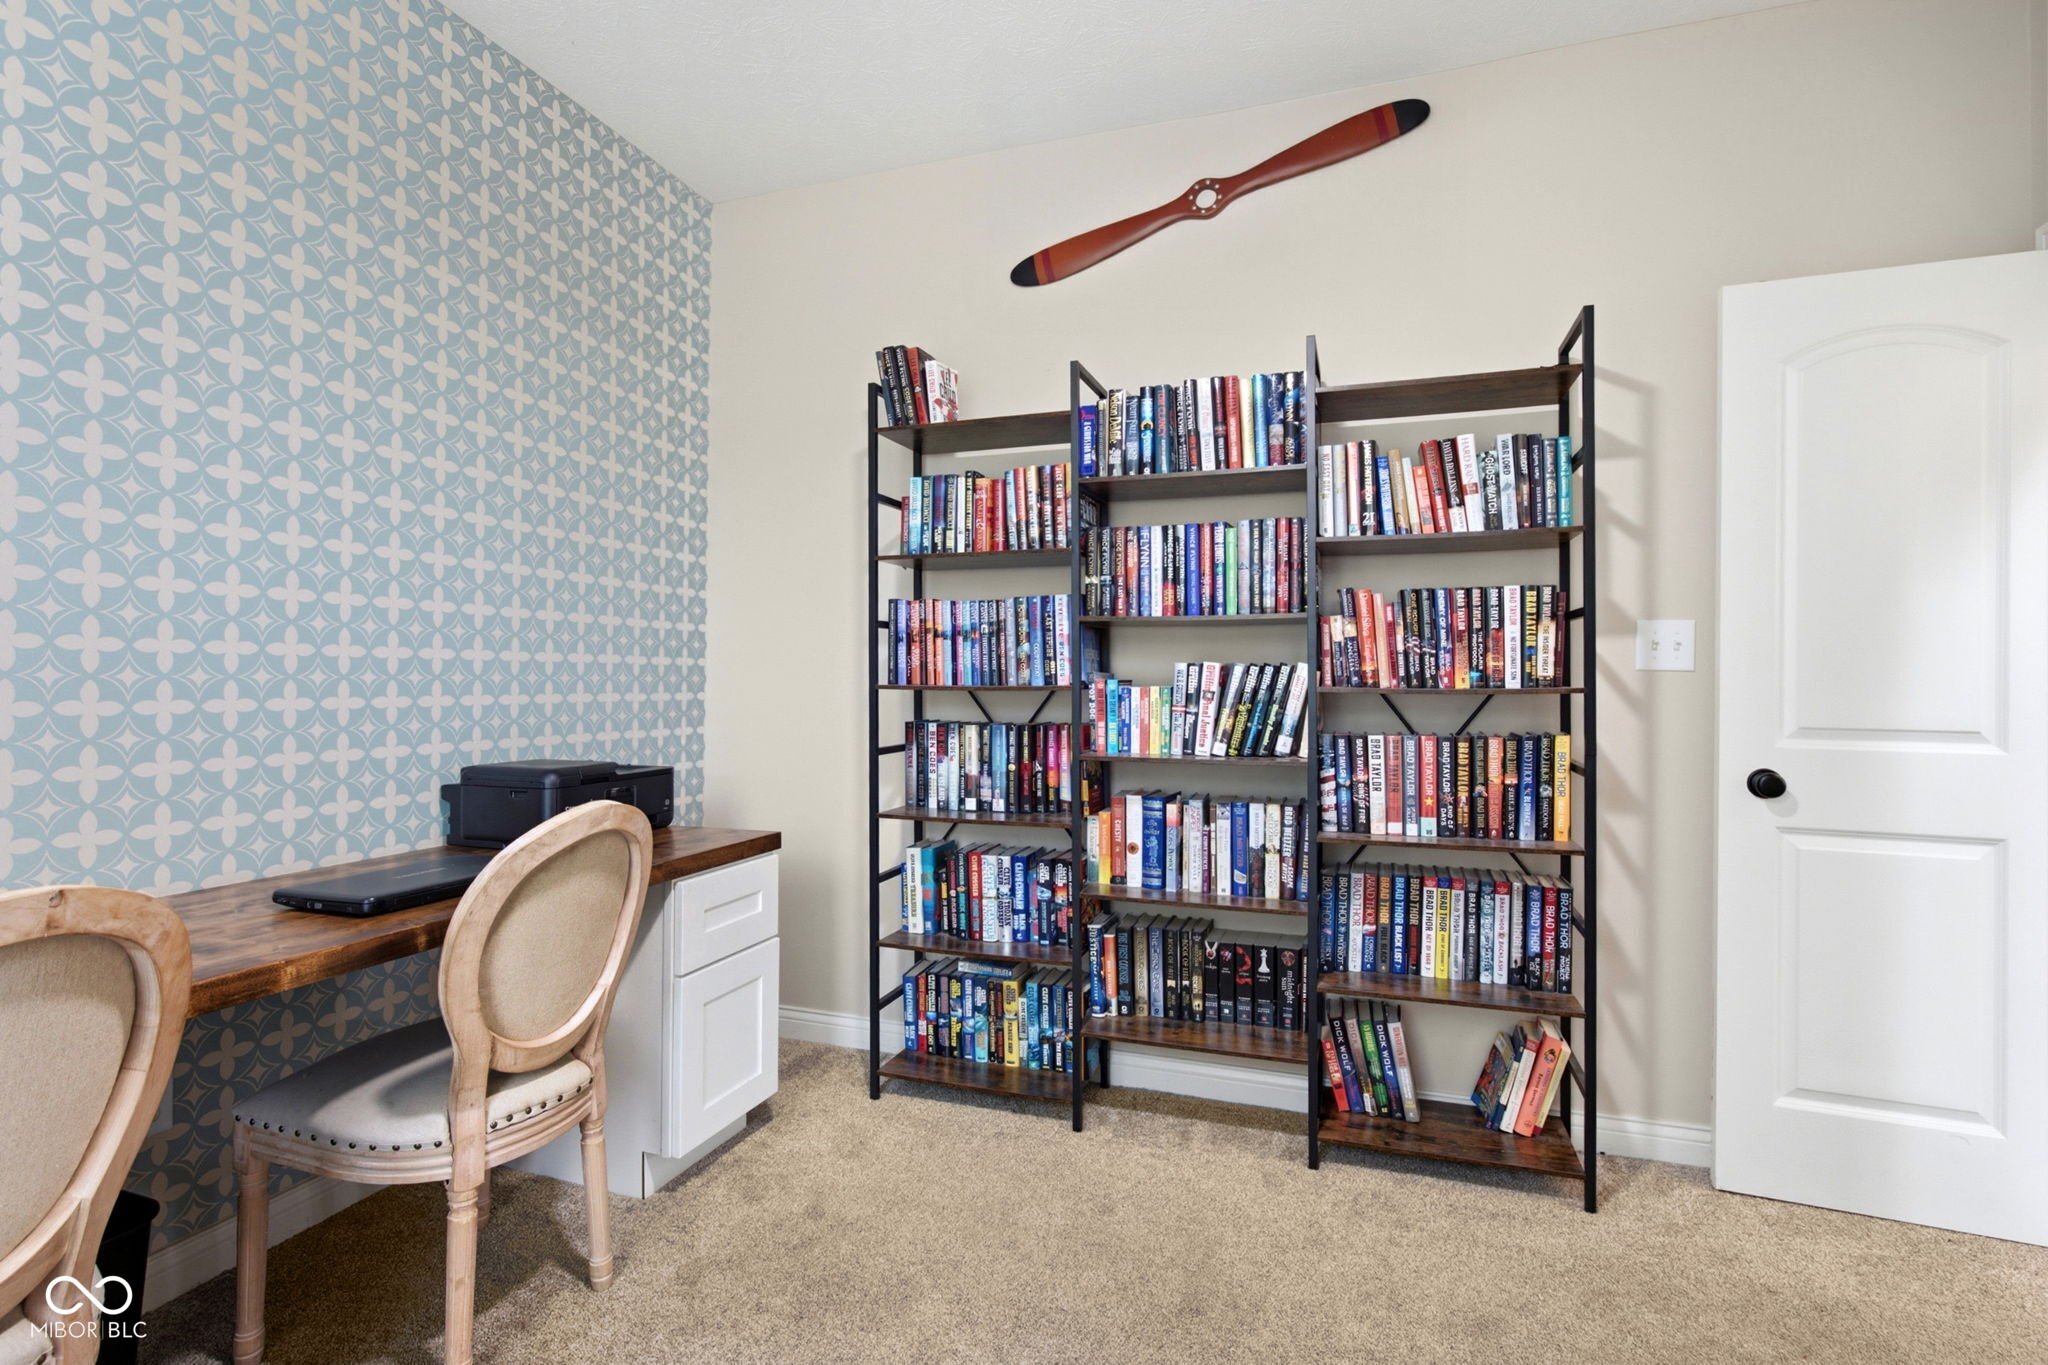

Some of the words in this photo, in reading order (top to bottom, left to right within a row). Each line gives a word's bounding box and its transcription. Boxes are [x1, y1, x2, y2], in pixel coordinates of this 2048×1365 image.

[1109, 390, 1122, 416] Nelson
[1177, 413, 1185, 435] FLYNN
[1364, 444, 1372, 464] JAMES
[1501, 439, 1509, 455] WAR
[1486, 457, 1495, 484] GHOST
[1502, 456, 1511, 476] LORD
[1365, 466, 1373, 504] PATTERSON
[1488, 486, 1497, 514] WATCH
[1362, 512, 1375, 526] 21
[1140, 532, 1150, 568] FLYNN
[1472, 589, 1481, 606] BRAD
[1526, 591, 1537, 613] BRAD
[1473, 607, 1481, 628] TAYLOR
[1526, 615, 1537, 646] TAYLOR
[1205, 664, 1216, 691] Griffin
[1202, 699, 1212, 718] Final
[1199, 719, 1210, 748] Justice
[1370, 738, 1381, 760] BRAD
[1442, 742, 1450, 763] BRAD
[1457, 742, 1469, 764] BRAD
[1524, 741, 1532, 761] BRAD
[1524, 762, 1533, 784] THOR
[1542, 761, 1550, 781] THOR
[1557, 752, 1566, 774] BRAD
[1372, 763, 1382, 792] TAYLOR
[1425, 765, 1433, 796] TAYLOR
[1442, 764, 1450, 792] TAYLOR
[1458, 766, 1469, 797] TAYLOR
[1557, 777, 1566, 797] THOR
[1284, 806, 1292, 825] BRAD
[1448, 820, 1453, 828] OF
[1282, 827, 1293, 857] MELTZER
[1339, 877, 1347, 899] BRAD
[1352, 878, 1362, 900] BRAD
[1366, 876, 1375, 898] BRAD
[1380, 877, 1390, 899] BRAD
[1395, 877, 1405, 900] BRAD
[1410, 878, 1420, 901] BRAD
[1426, 890, 1434, 910] BRAD
[1439, 890, 1448, 910] BRAD
[1560, 893, 1569, 918] BRAD
[1338, 901, 1347, 924] THOR
[1352, 903, 1361, 927] THOR
[1363, 900, 1374, 923] THOR
[1380, 902, 1389, 924] THOR
[1394, 902, 1404, 924] THOR
[1410, 903, 1419, 925] THOR
[1425, 912, 1434, 931] THOR
[1439, 913, 1447, 932] THOR
[1531, 901, 1540, 926] BRAD
[1546, 905, 1554, 928] BRAD
[1394, 925, 1403, 947] BLACK
[1531, 928, 1540, 952] THOR
[1545, 931, 1555, 953] THOR
[1560, 922, 1568, 948] THOR
[1394, 948, 1402, 963] LIST
[1119, 960, 1129, 984] COUNSEL
[1285, 971, 1295, 1004] midnight
[1333, 1021, 1344, 1043] DICK
[1340, 1045, 1351, 1071] WOLF
[1376, 1024, 1387, 1048] DICK
[1382, 1050, 1393, 1076] WOLF
